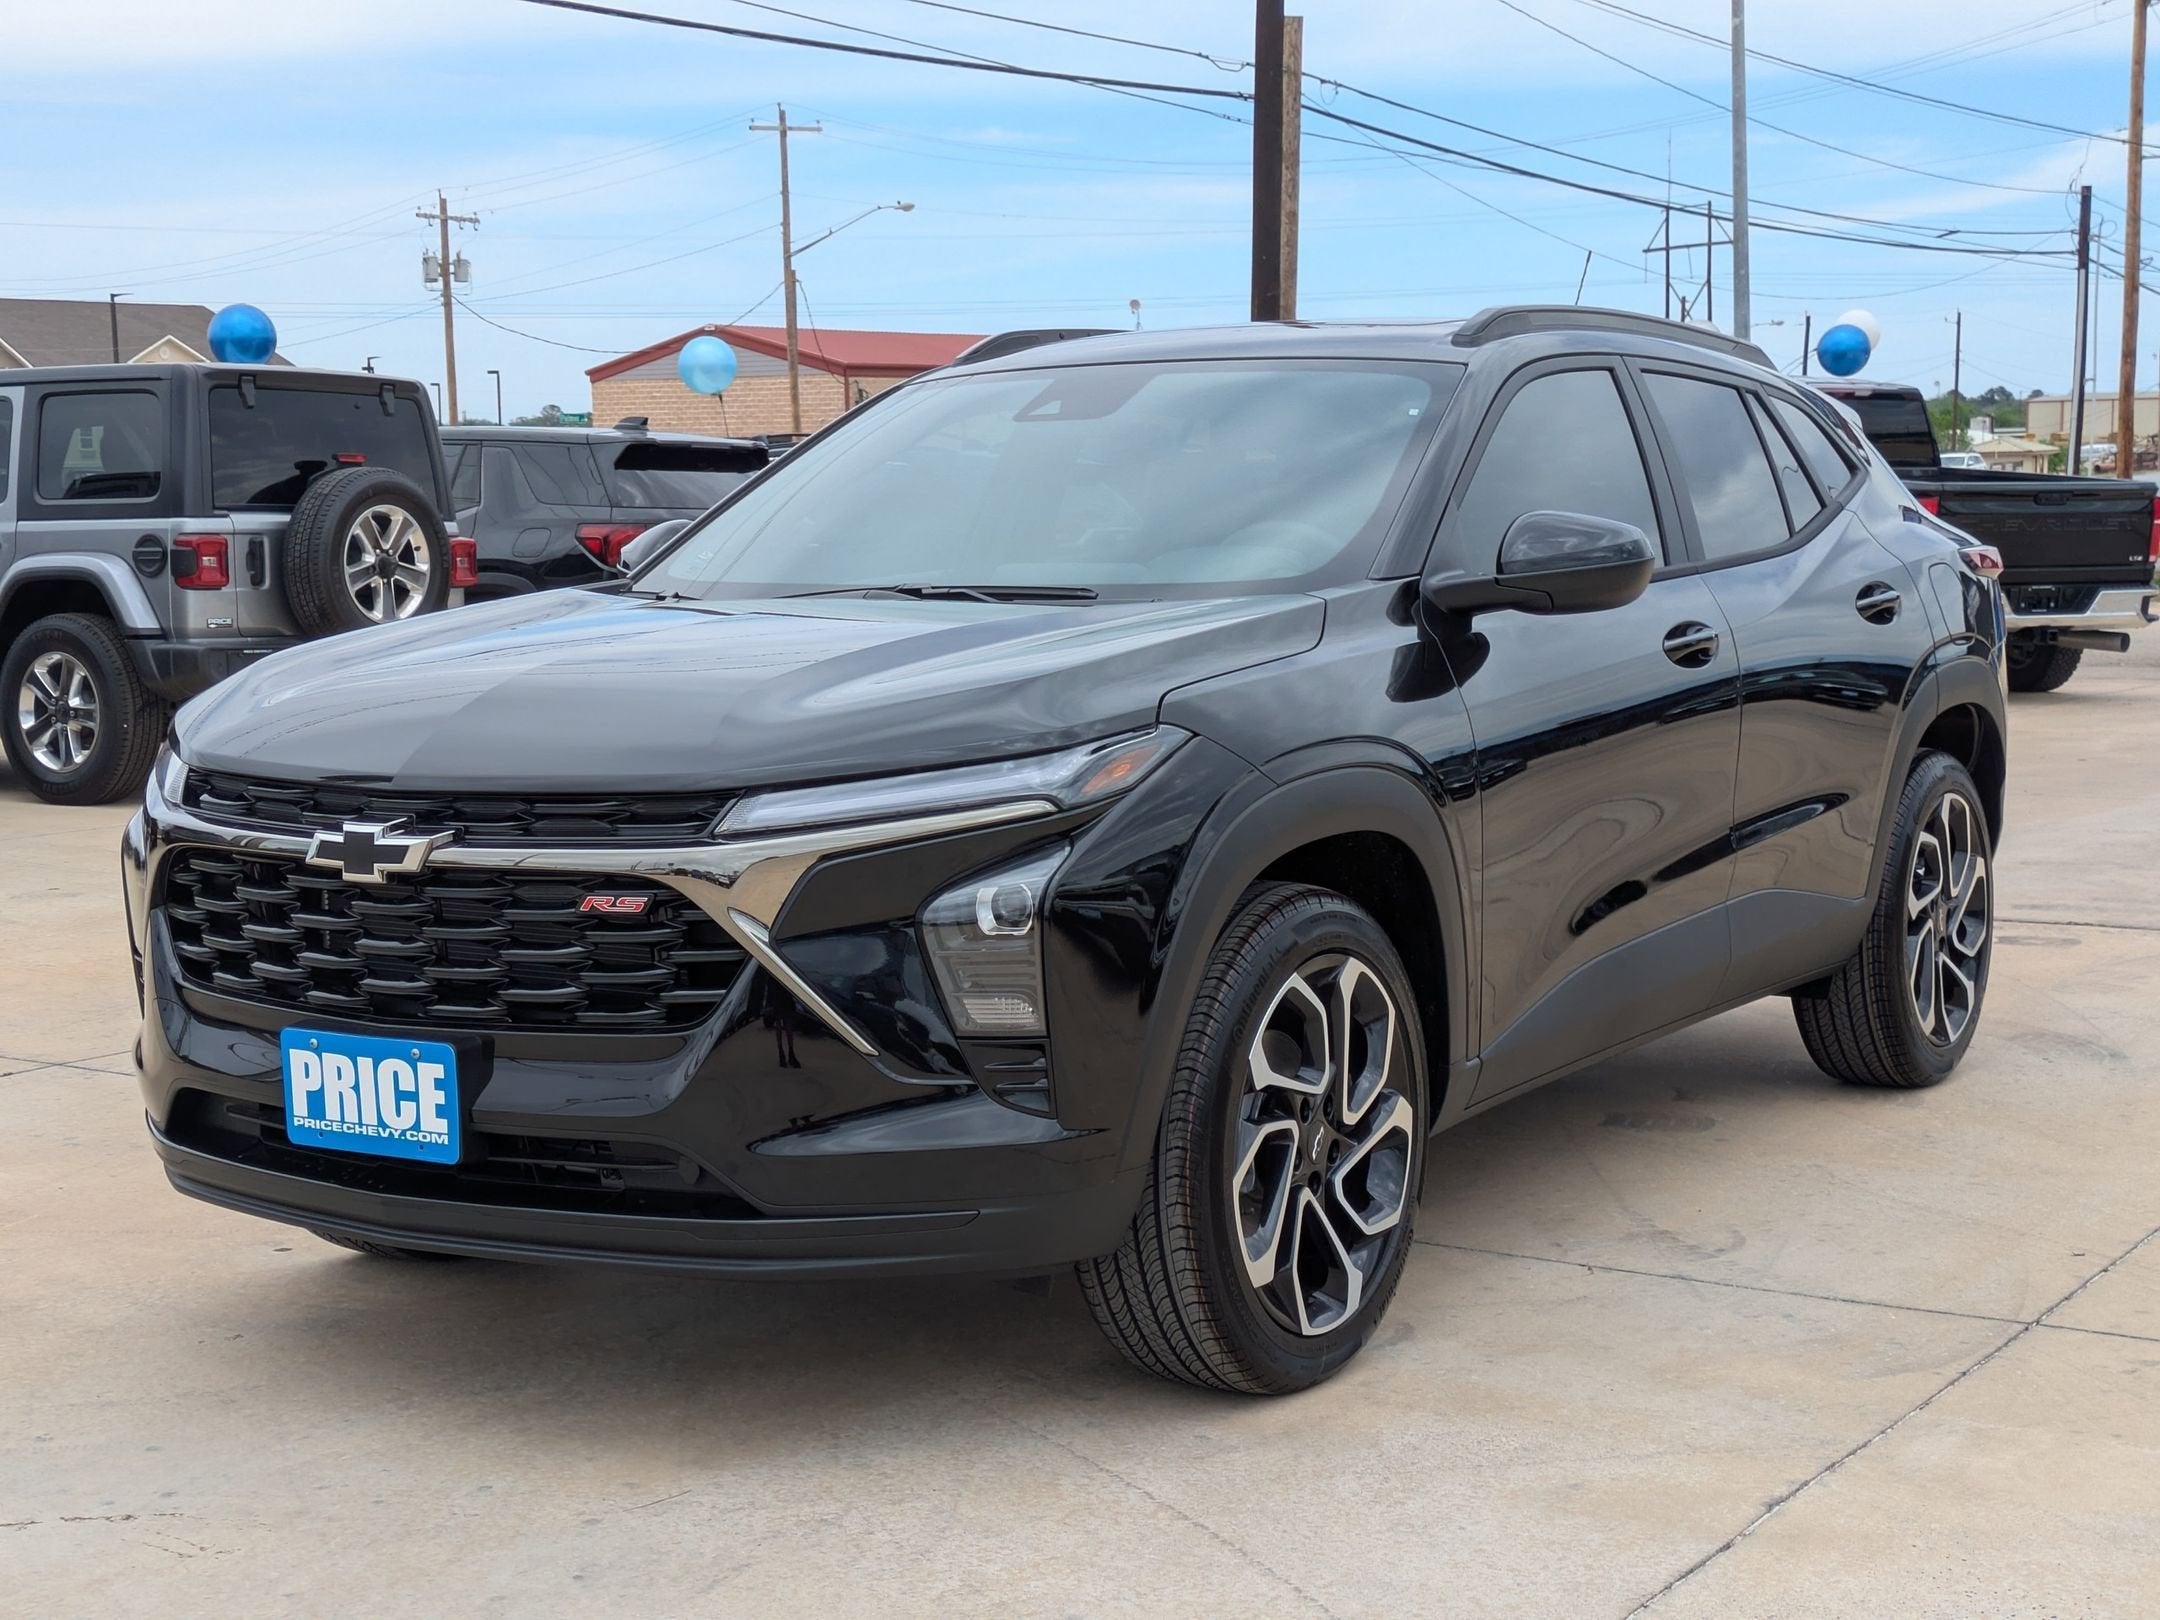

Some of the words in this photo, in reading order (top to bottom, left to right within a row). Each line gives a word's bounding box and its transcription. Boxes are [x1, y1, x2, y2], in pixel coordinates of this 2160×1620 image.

[580, 896, 648, 913] RS
[289, 1048, 448, 1133] PRICE
[293, 1116, 449, 1145] PRICECHEVY.COM
